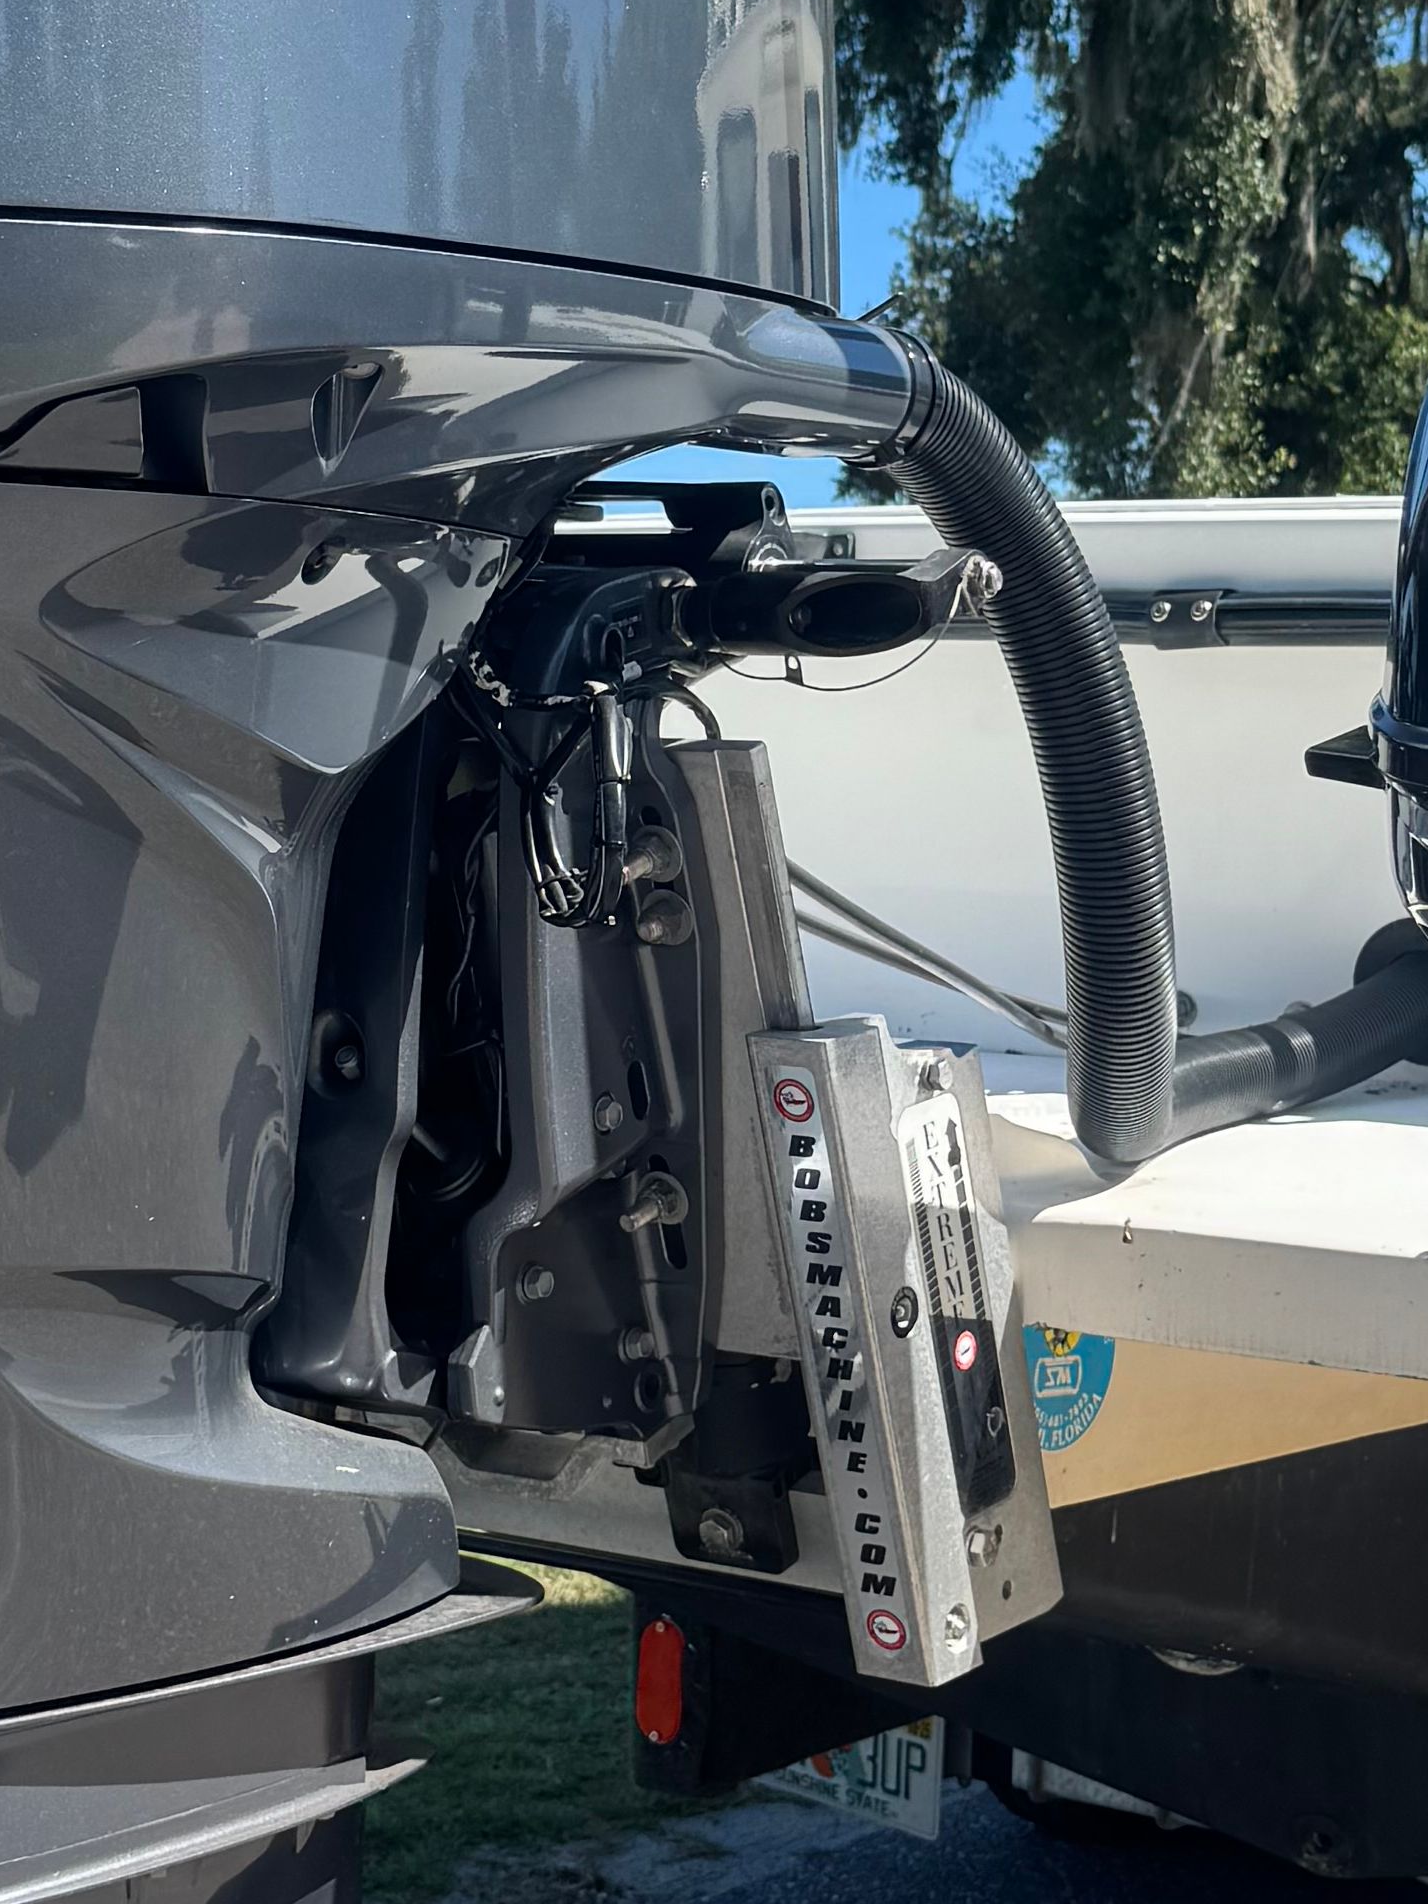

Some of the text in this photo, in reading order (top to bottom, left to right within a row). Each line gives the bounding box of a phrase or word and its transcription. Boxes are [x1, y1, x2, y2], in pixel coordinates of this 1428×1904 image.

[789, 1134, 897, 1597] BOBSMACHINE.COM
[1051, 1393, 1102, 1448] FLORIDA
[845, 1787, 891, 1818] STATE
